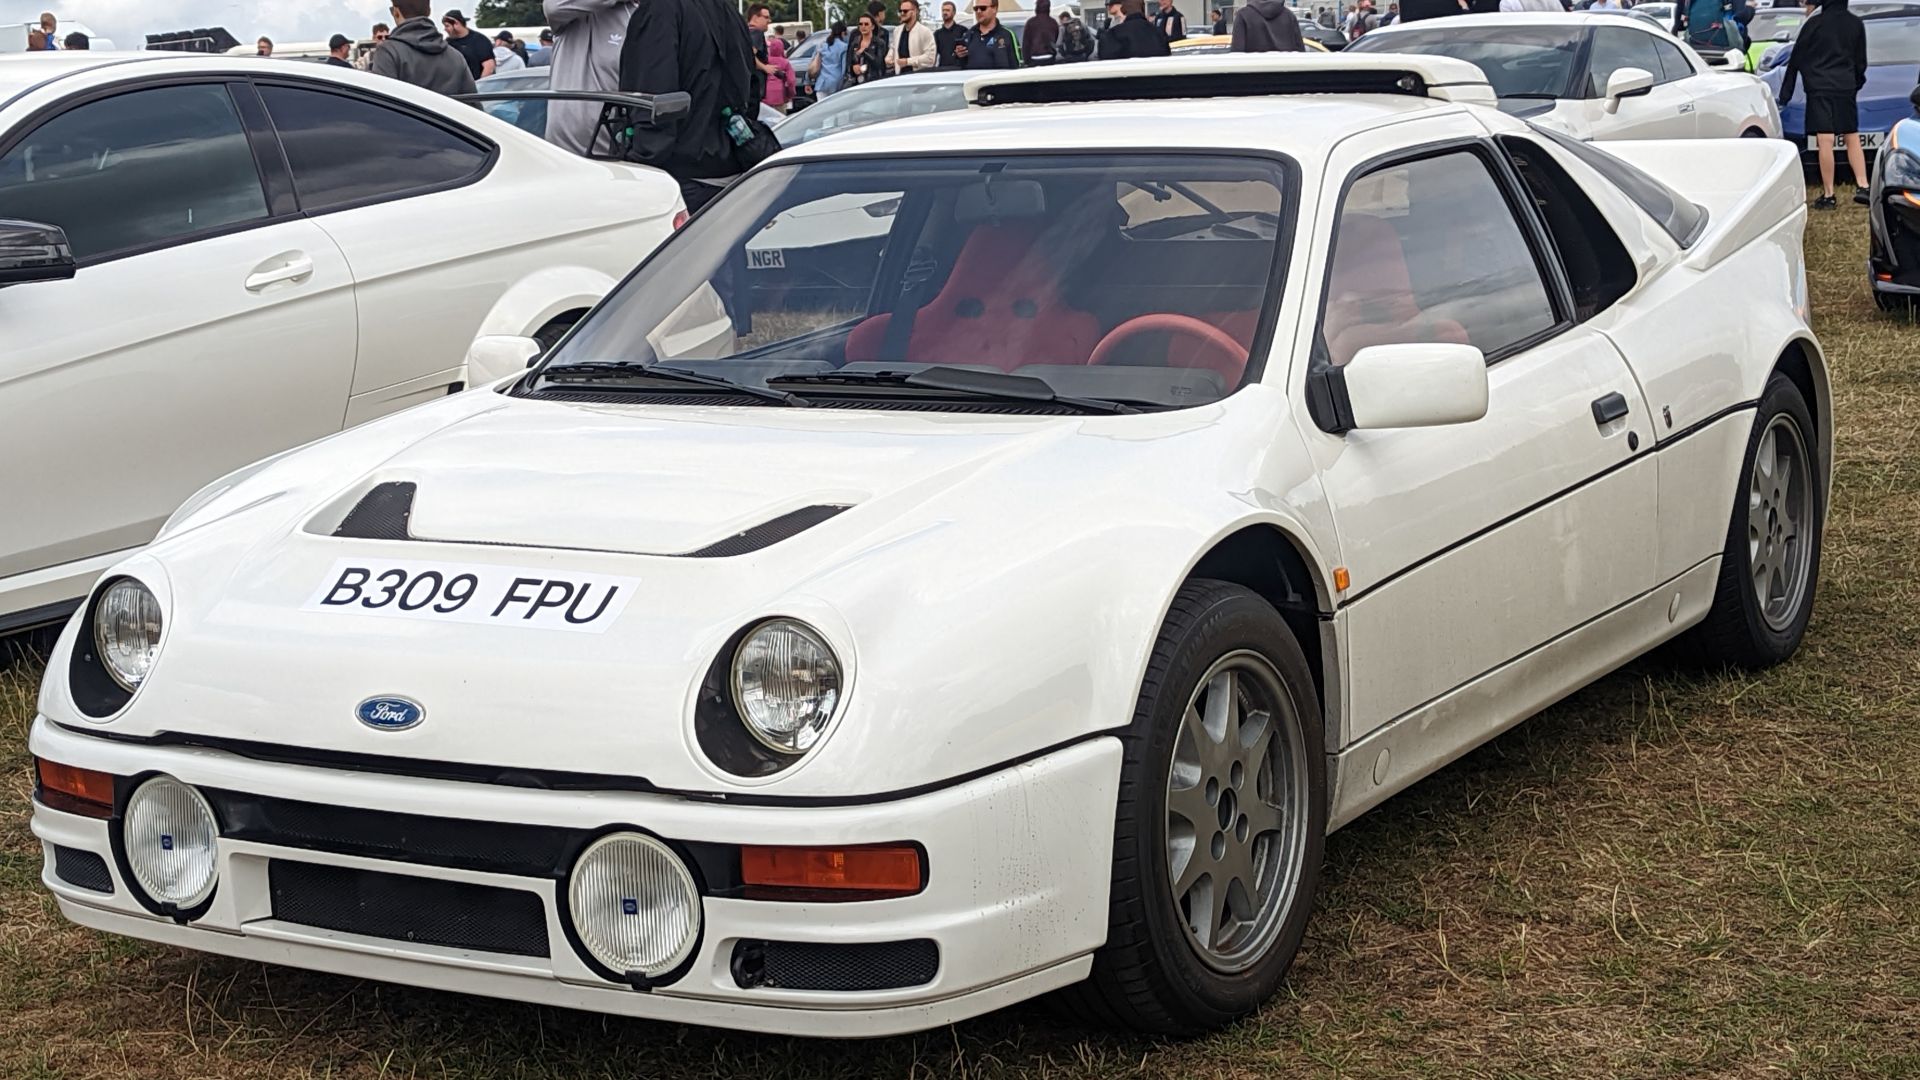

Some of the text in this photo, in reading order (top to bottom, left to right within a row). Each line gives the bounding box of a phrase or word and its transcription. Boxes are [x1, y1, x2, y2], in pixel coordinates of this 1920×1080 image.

[751, 250, 782, 267] NGR
[320, 567, 619, 624] B309 FPU
[369, 702, 409, 722] Ford
